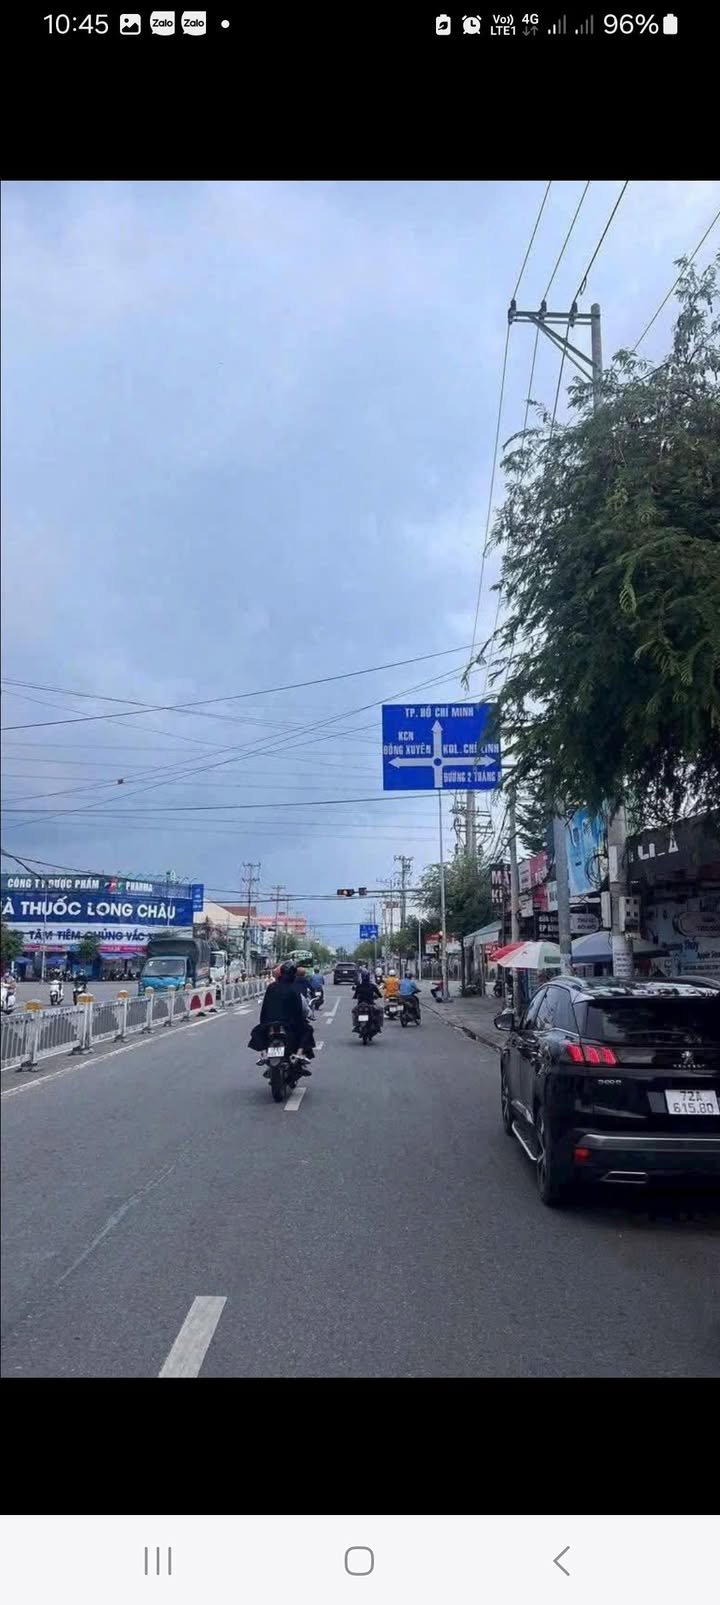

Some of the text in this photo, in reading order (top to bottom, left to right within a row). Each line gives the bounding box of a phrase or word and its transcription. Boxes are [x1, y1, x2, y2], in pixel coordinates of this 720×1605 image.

[405, 708, 418, 718] TP.
[451, 706, 474, 718] MINH
[398, 730, 414, 741] KCN
[405, 742, 432, 755] XUYÊN
[463, 741, 477, 754] CHÍ
[467, 772, 472, 783] 2
[7, 878, 32, 889] CÔNG
[74, 877, 100, 889] PHẨM
[126, 881, 153, 892] PHARMA
[0, 895, 176, 920] À THUỐC LONG CHÂU
[679, 1090, 704, 1102] 72A
[673, 1102, 714, 1113] 615.80
